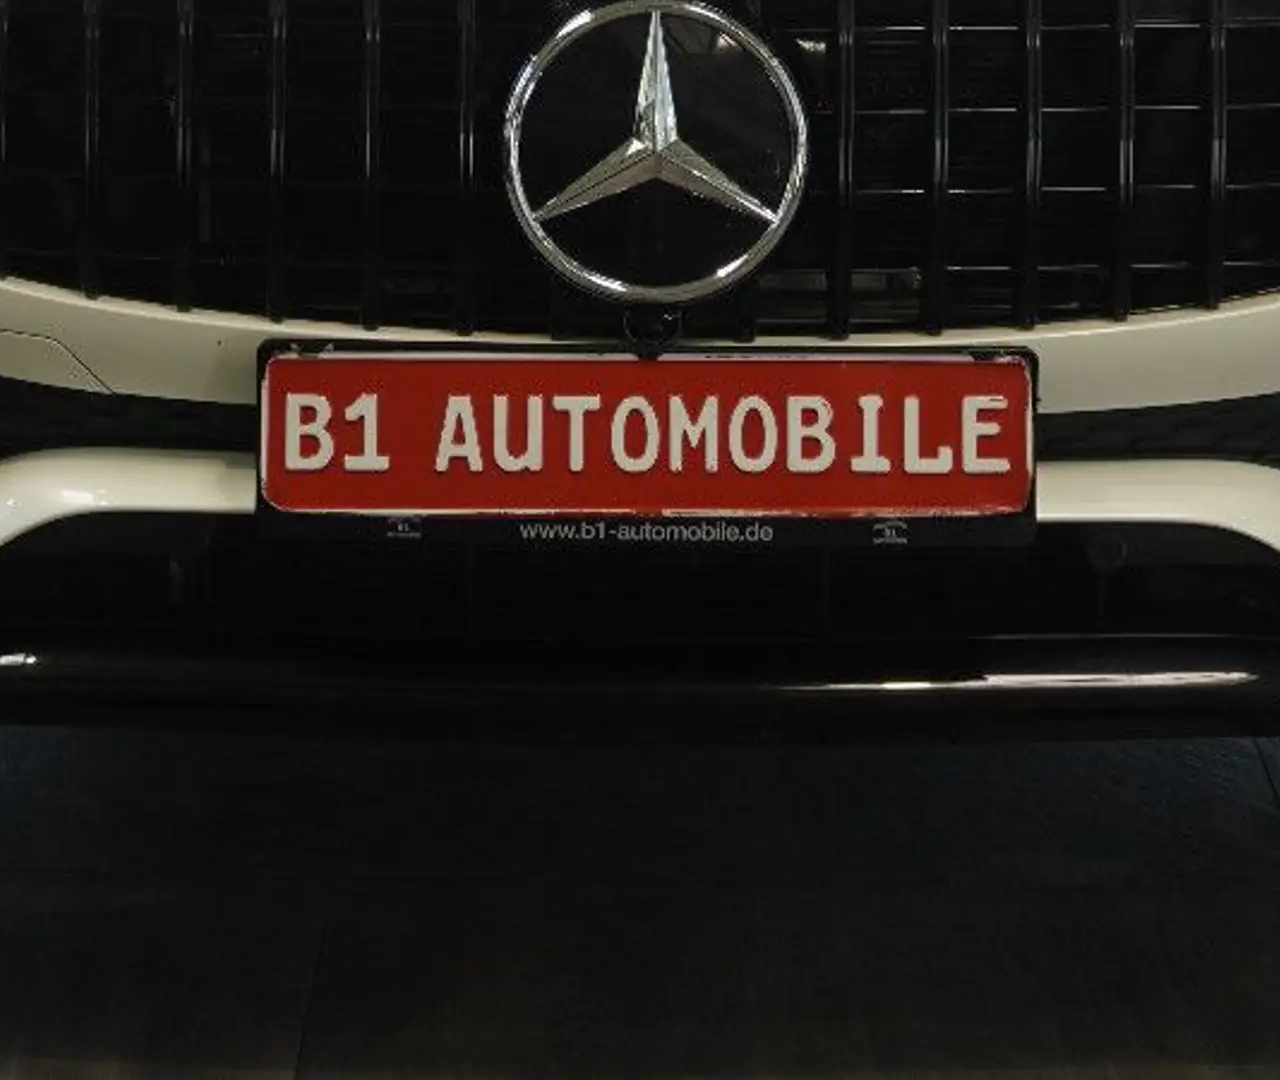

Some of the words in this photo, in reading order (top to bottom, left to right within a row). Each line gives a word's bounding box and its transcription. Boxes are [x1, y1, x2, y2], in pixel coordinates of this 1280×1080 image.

[285, 392, 390, 471] B1
[434, 394, 1011, 473] AUTOMOBILE
[519, 521, 774, 542] www.b1-automobile.de
